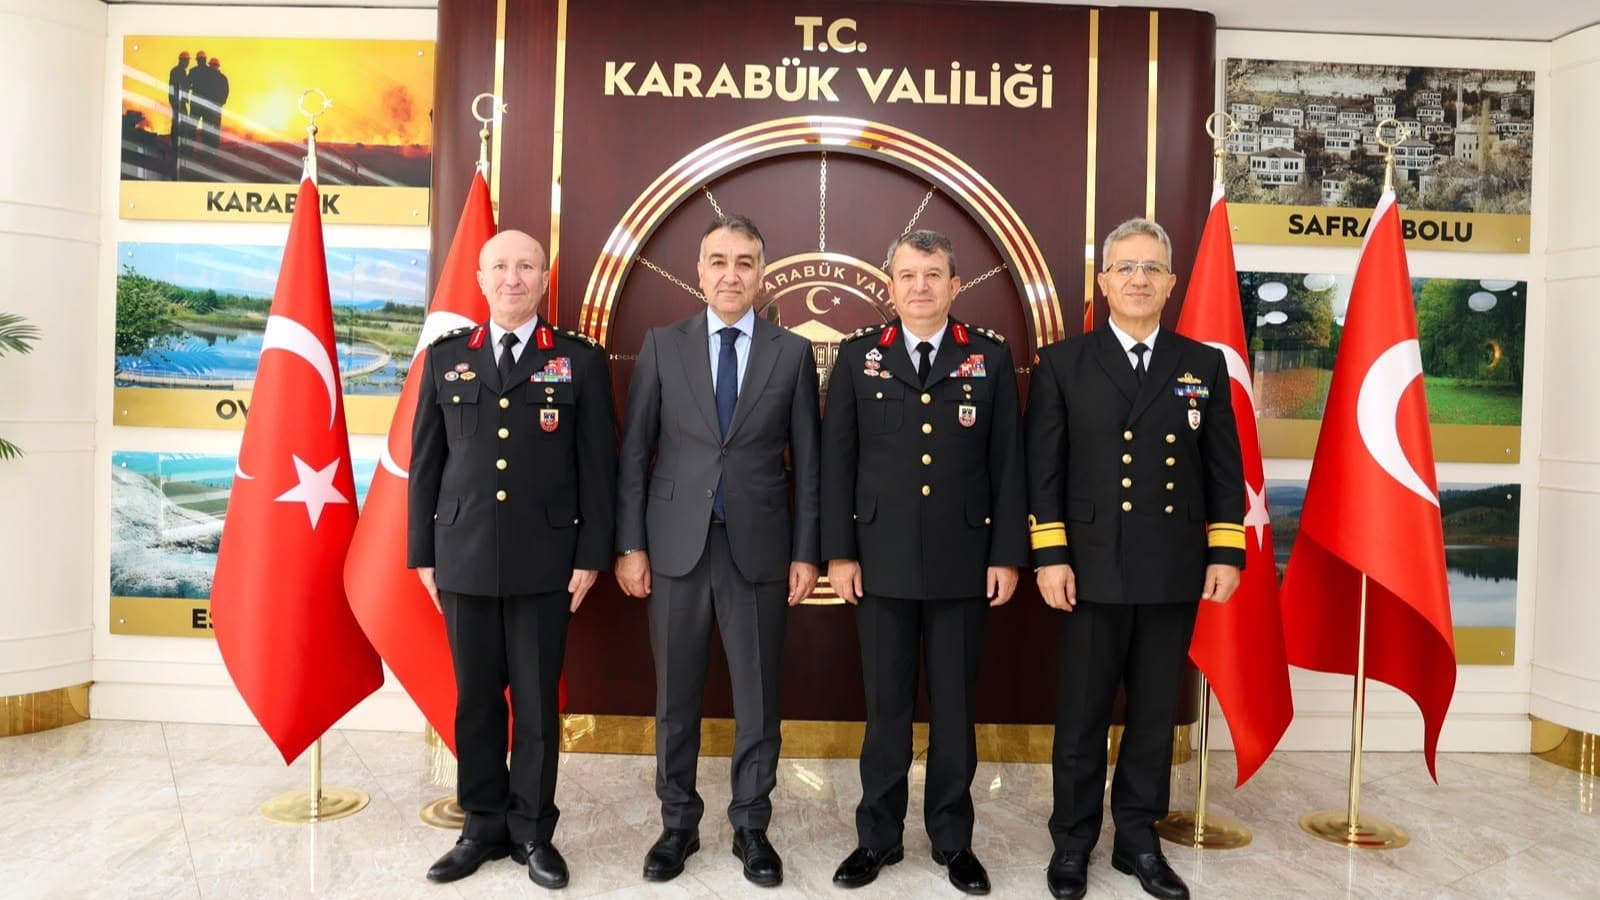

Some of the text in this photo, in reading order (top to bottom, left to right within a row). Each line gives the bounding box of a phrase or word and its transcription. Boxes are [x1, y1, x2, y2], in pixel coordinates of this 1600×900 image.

[795, 16, 867, 53] T.C.
[604, 57, 1053, 109] KARABÜK VALİLİĞİ
[207, 191, 340, 215] KARABK
[764, 262, 846, 294] ARABÜK
